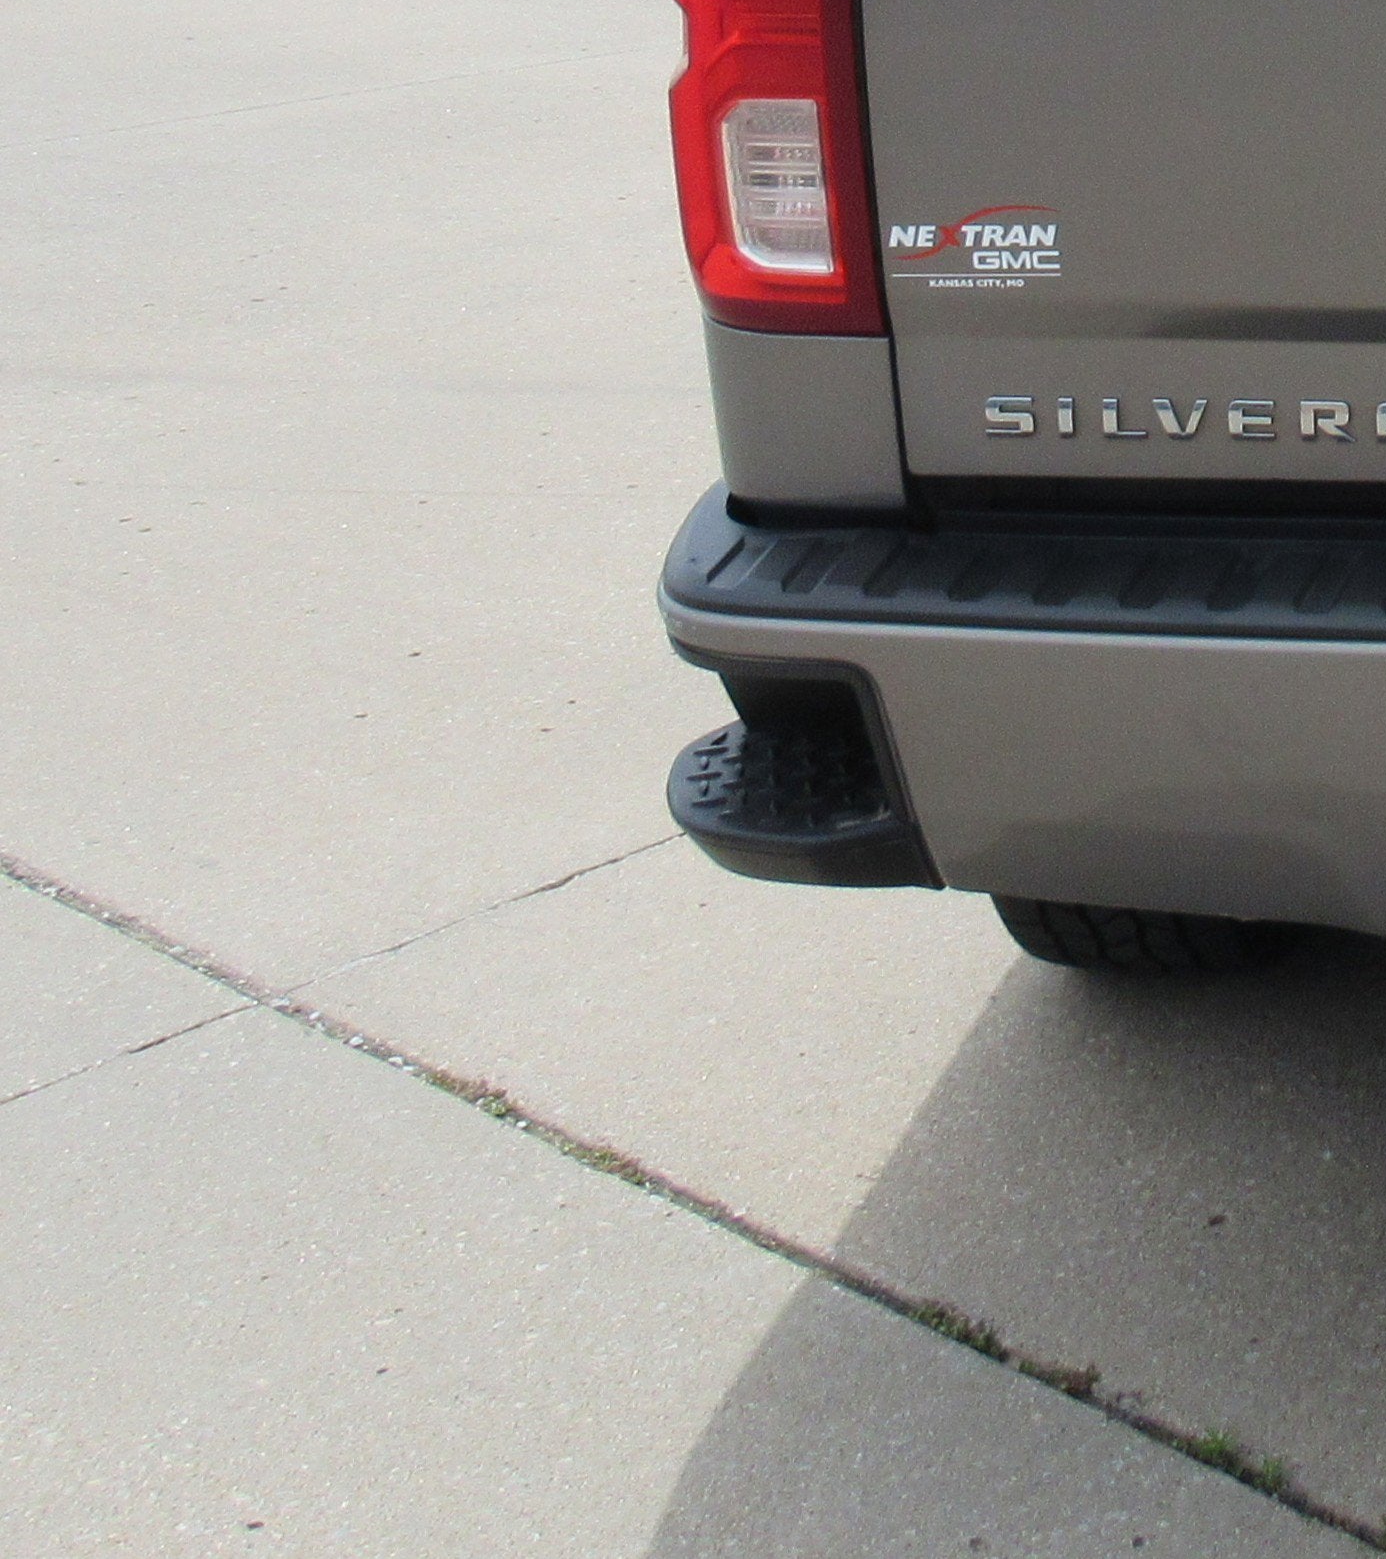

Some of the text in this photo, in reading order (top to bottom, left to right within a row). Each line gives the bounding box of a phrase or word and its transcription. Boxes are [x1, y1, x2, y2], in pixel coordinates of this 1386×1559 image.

[888, 224, 1057, 248] NEXTRAN
[972, 250, 1061, 270] GMC
[928, 278, 1025, 289] KANSAS CITY, MO
